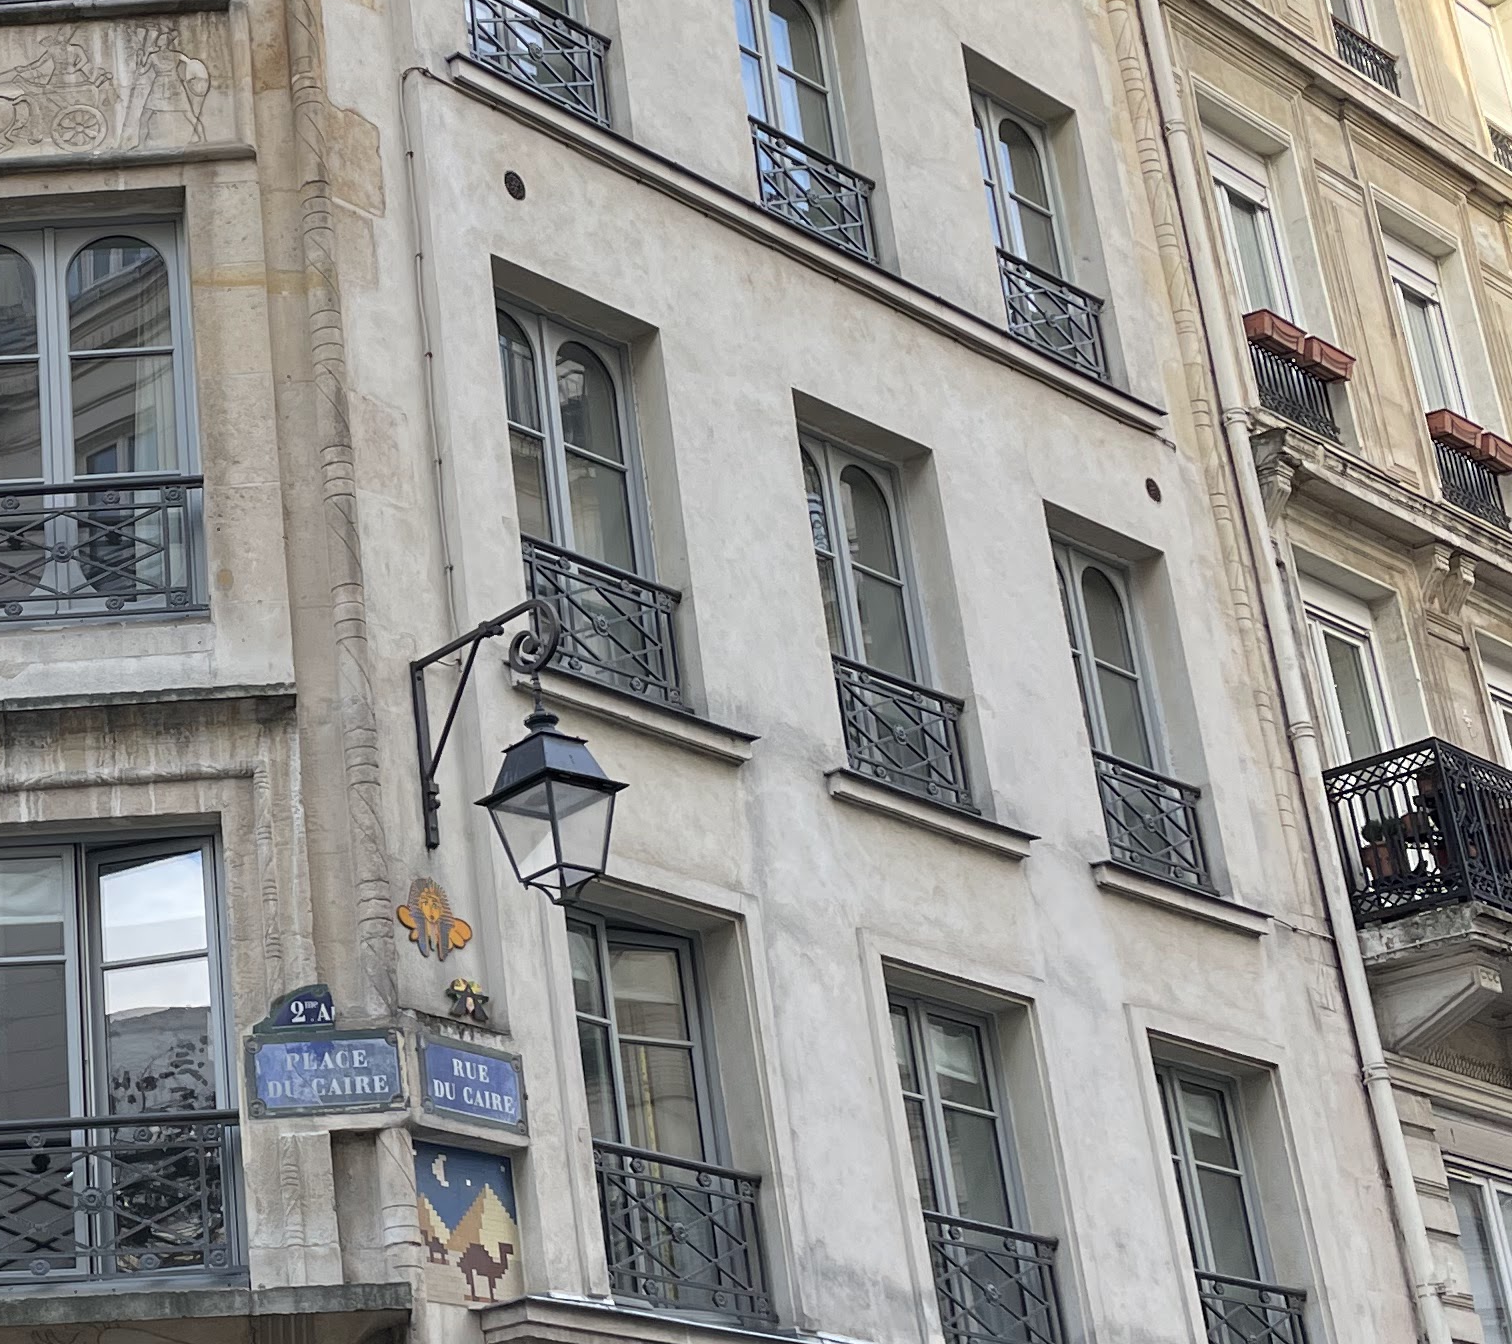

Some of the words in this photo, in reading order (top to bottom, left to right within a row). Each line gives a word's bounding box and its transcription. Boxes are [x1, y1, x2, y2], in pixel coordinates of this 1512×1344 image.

[285, 1049, 368, 1071] PLACE
[452, 1058, 489, 1083] RUE
[268, 1080, 296, 1098] DU
[314, 1074, 388, 1097] CAIRE
[433, 1078, 456, 1101] DU
[463, 1087, 516, 1114] CAIRE
